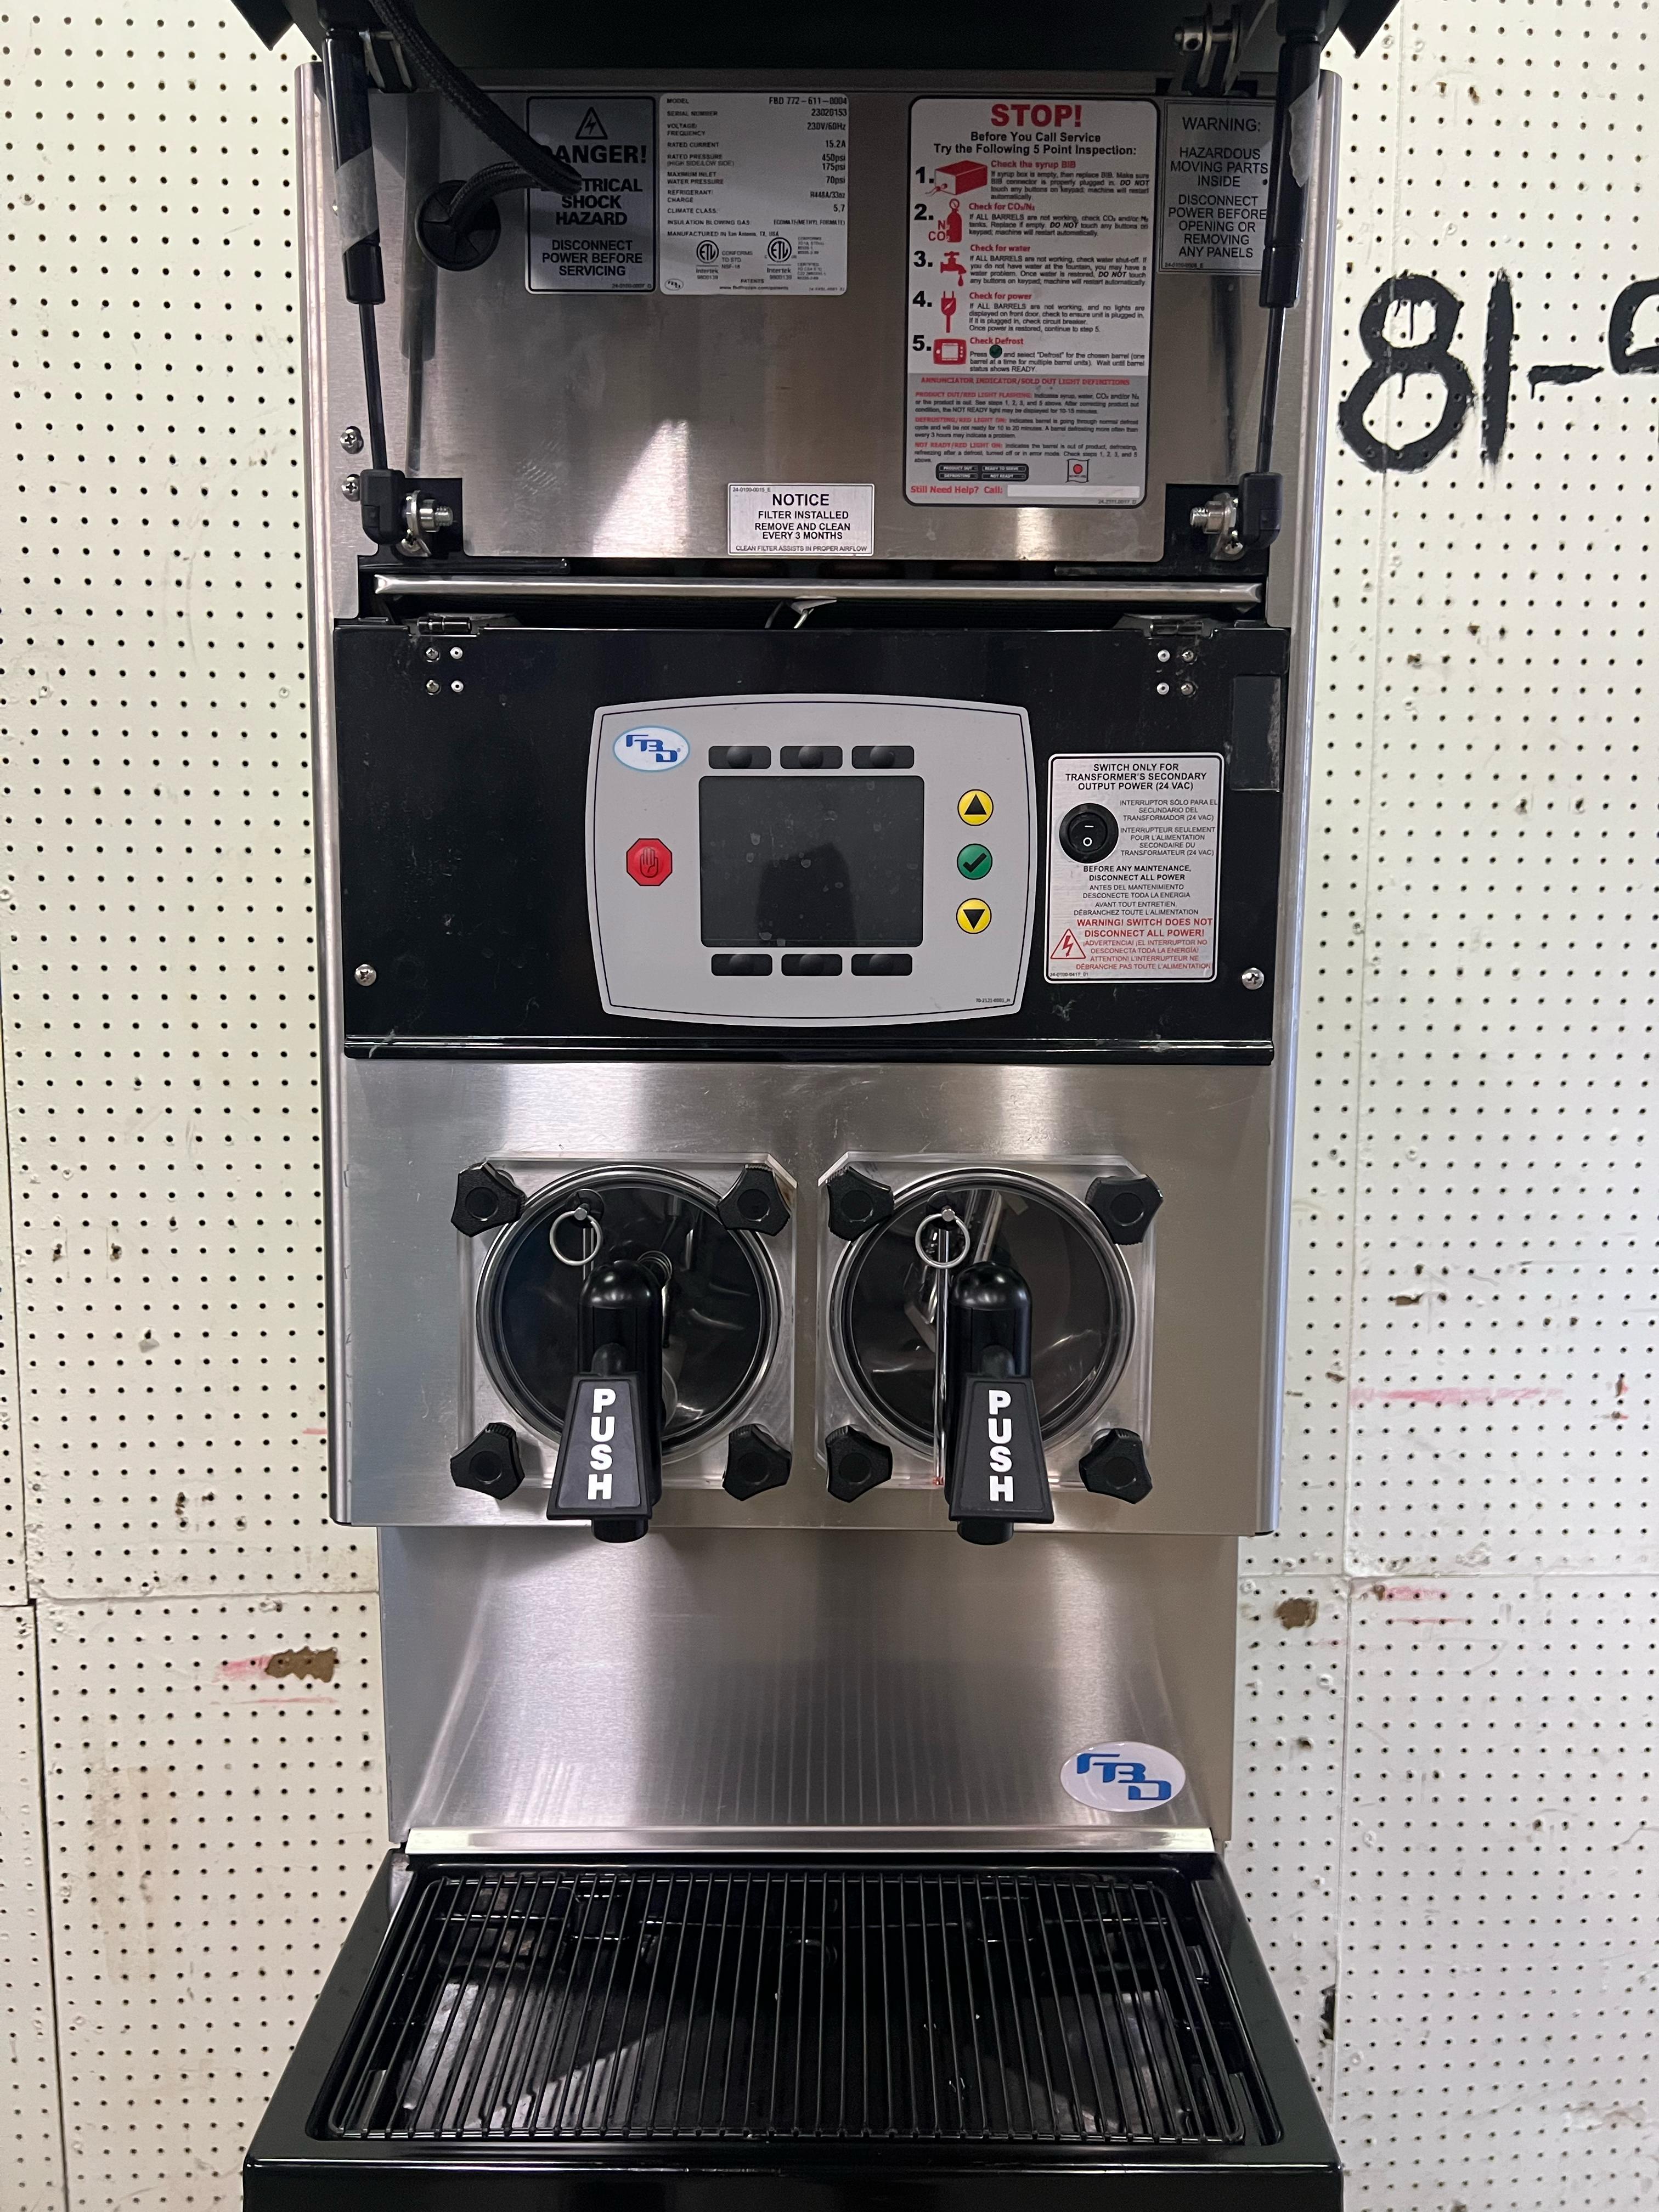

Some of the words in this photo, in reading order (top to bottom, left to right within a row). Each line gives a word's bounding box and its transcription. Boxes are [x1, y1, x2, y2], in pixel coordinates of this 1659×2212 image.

[991, 104, 1082, 127] STOP!
[1182, 116, 1261, 132] WARNING:
[971, 131, 1007, 142] Before
[1010, 131, 1032, 142] You
[1036, 132, 1057, 142] Call
[1060, 132, 1101, 143] Service
[826, 140, 846, 148] 15.2A
[934, 143, 952, 155] Try
[955, 143, 972, 154] the
[977, 143, 1030, 156] Following
[1034, 144, 1040, 154] 5
[1043, 144, 1072, 154] Point
[1075, 144, 1136, 157] Inspection:
[1180, 146, 1260, 160] HAZARDOUS
[1171, 161, 1222, 173] MOVING
[1227, 162, 1268, 174] PARTS
[826, 176, 845, 185] 70psi
[916, 166, 934, 184] 1.
[1198, 175, 1240, 187] INSIDE
[561, 194, 622, 209] SHOCK
[1179, 194, 1259, 206] DISCONNECT
[556, 212, 628, 225] HAZARD
[914, 204, 934, 221] 2.
[1169, 207, 1214, 218] POWER
[1218, 208, 1267, 219] BEFORE
[1179, 221, 1234, 232] OPENING
[1238, 222, 1256, 233] OR
[552, 239, 633, 251] DISCONNECT
[1184, 233, 1249, 245] REMOVING
[542, 252, 588, 263] POWER
[592, 252, 642, 263] BEFORE
[1179, 246, 1204, 257] ANY
[1207, 247, 1253, 258] PANELS
[913, 250, 933, 267] 3.
[559, 266, 625, 276] SERVICING
[912, 291, 932, 307] 4.
[912, 335, 932, 351] 5.
[994, 337, 1024, 346] Defrost
[930, 486, 952, 494] Need
[955, 486, 979, 495] Help?
[773, 494, 830, 506] NOTICE
[759, 511, 792, 519] FILTER
[795, 511, 849, 519] INSTALLED
[803, 532, 843, 540] MONTHS
[626, 735, 678, 762] FBD
[1065, 773, 1146, 781] TRANSFORMER'S
[1148, 772, 1207, 781] SECONDARY
[1078, 782, 1116, 791] OUTPUT
[1156, 782, 1169, 791] (24
[1171, 782, 1193, 791] VAC)
[1085, 929, 1145, 938] DISCONNECT
[587, 1388, 617, 1500] PUSH
[988, 1389, 1015, 1503] PUSH
[1077, 1753, 1171, 1801] FBD
